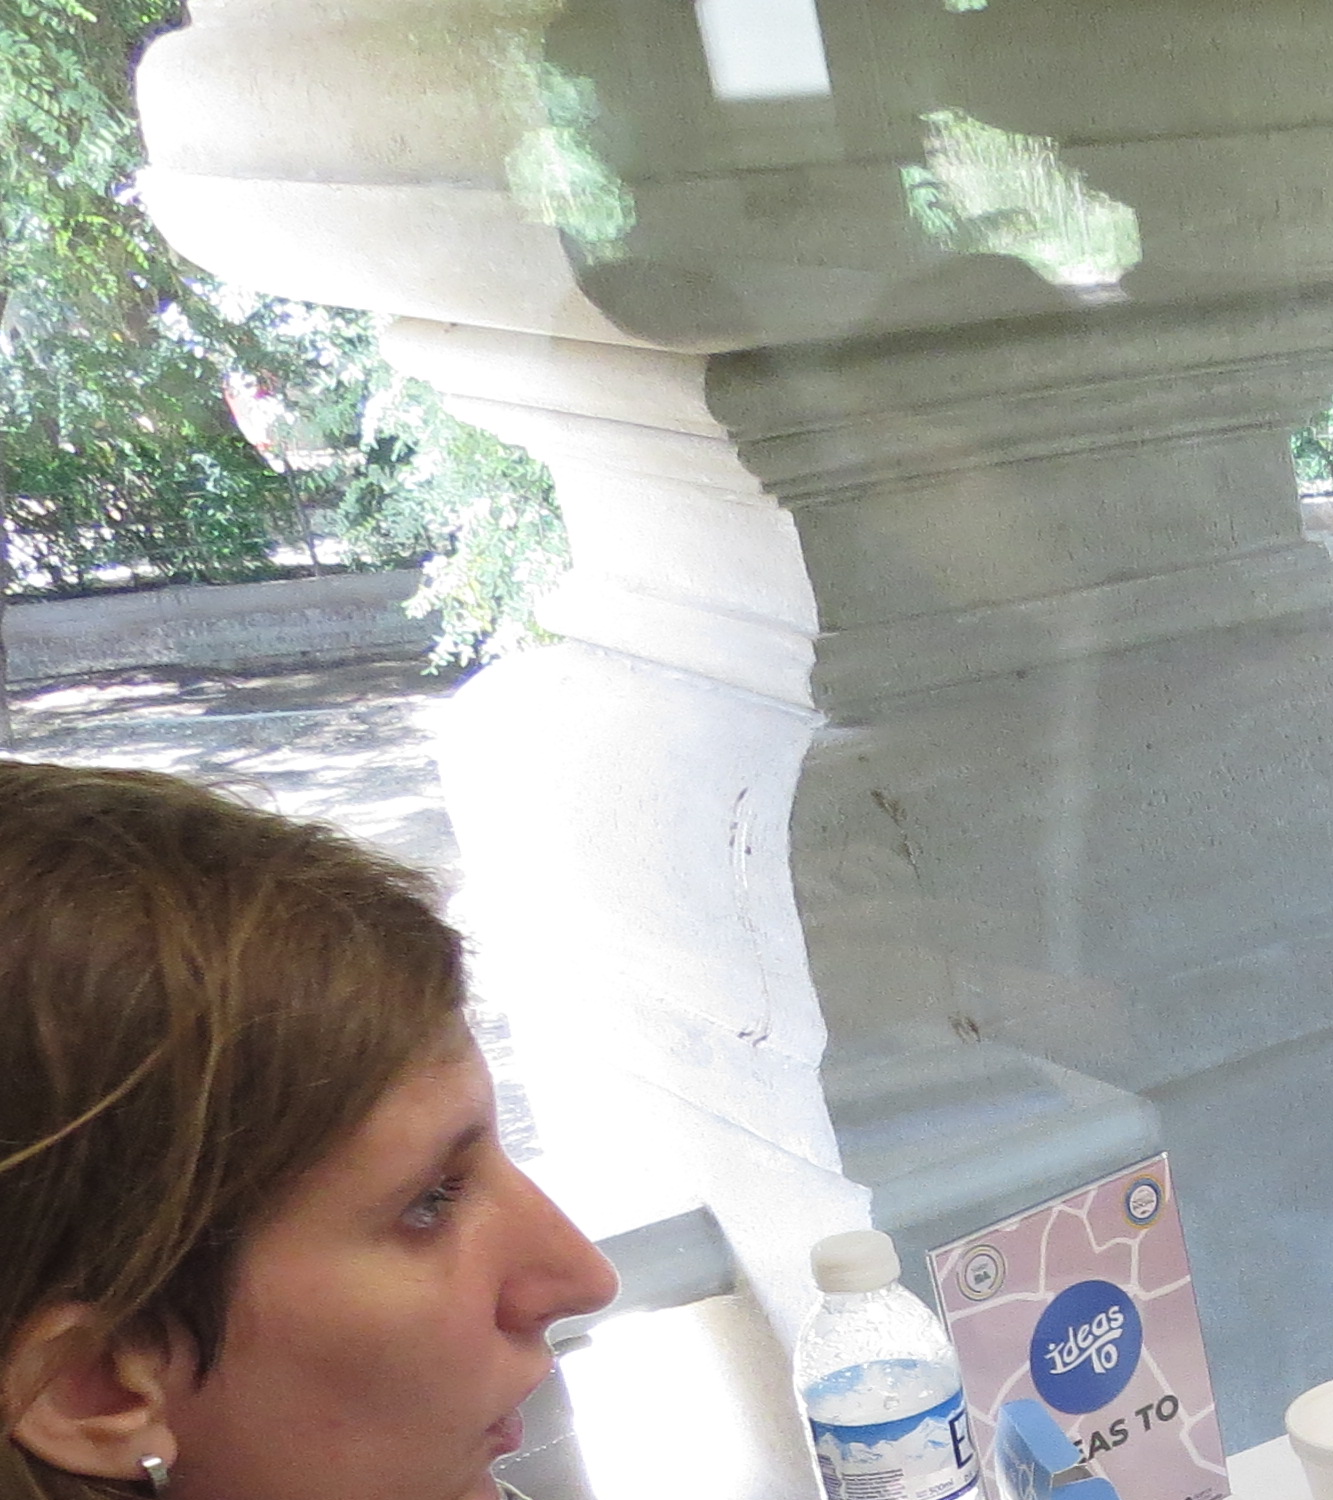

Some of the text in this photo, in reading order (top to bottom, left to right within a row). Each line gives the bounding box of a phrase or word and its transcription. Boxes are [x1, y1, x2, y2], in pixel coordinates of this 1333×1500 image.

[1045, 1305, 1124, 1374] ideas
[1073, 1395, 1179, 1464] EAS TO
